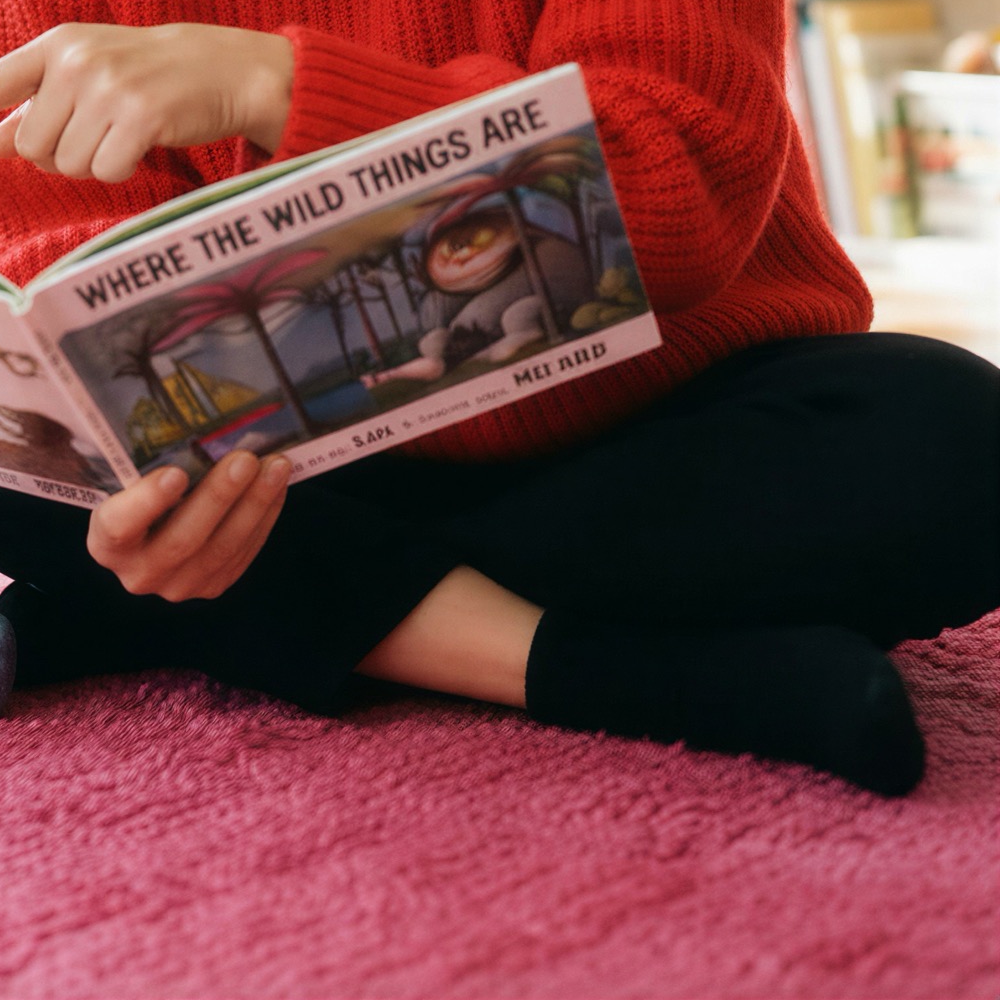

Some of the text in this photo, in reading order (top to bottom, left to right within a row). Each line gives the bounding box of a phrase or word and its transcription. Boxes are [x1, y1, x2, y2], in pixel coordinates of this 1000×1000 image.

[75, 99, 548, 309] WHERE THE WILD THINGS ARE
